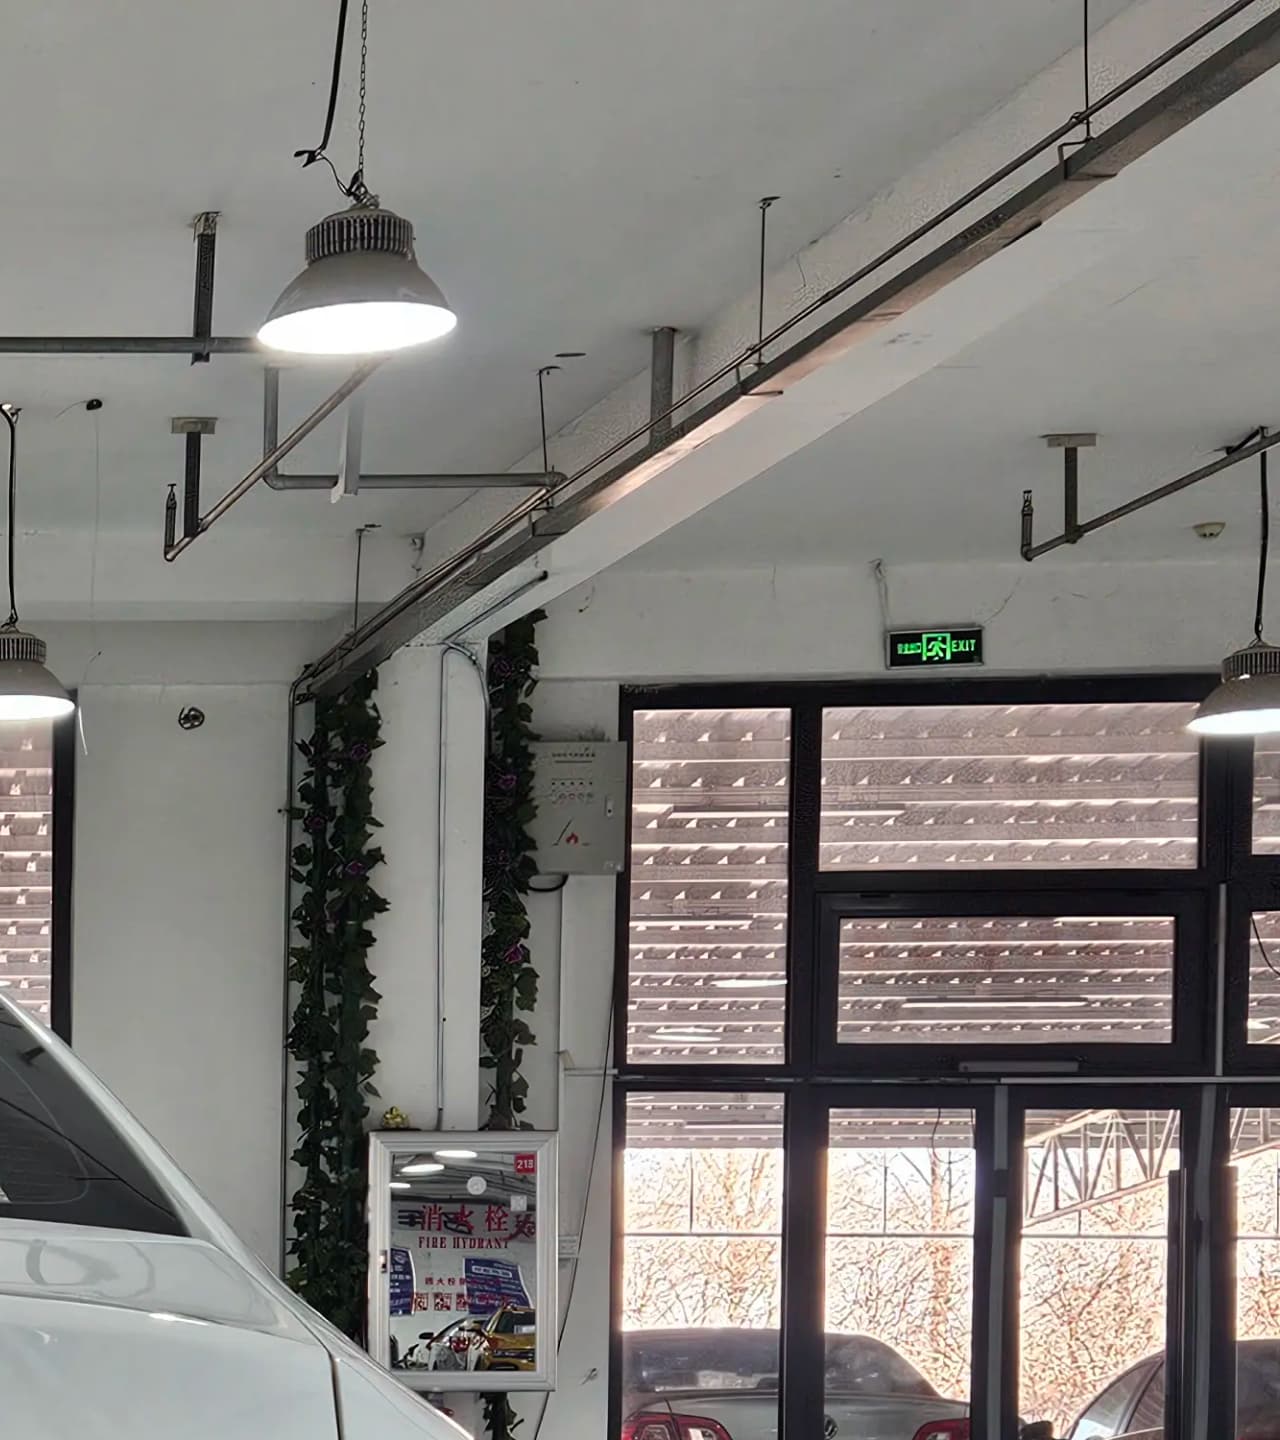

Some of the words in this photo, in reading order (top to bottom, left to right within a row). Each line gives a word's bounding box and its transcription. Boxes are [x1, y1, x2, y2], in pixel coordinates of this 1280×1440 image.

[951, 639, 977, 652] EXIT
[420, 1202, 509, 1232] 消火栓
[418, 1236, 447, 1249] FIRE
[452, 1236, 509, 1249] HYDRANT
